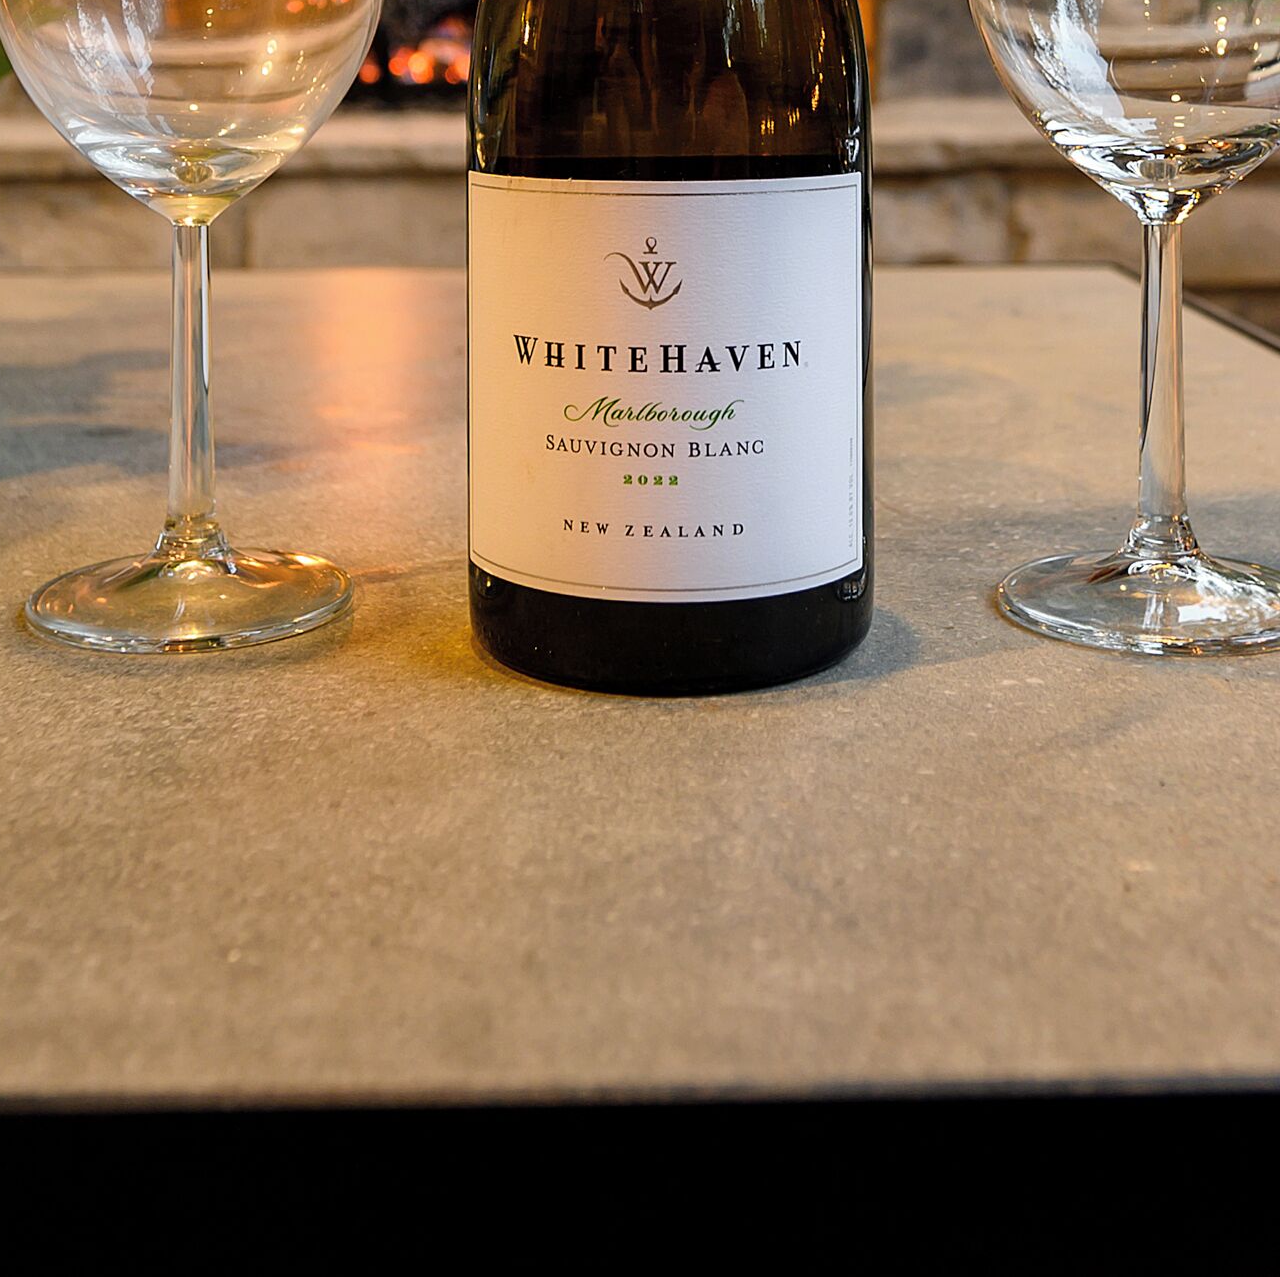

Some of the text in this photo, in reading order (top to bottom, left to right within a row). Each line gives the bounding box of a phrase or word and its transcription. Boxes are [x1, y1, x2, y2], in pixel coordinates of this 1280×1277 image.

[513, 334, 802, 374] WHITEHAVEN
[563, 395, 745, 431] Marlborough
[545, 434, 765, 459] SAUVIGNON BLANC
[622, 474, 679, 486] 2022
[563, 518, 745, 538] NEW ZEALAND
